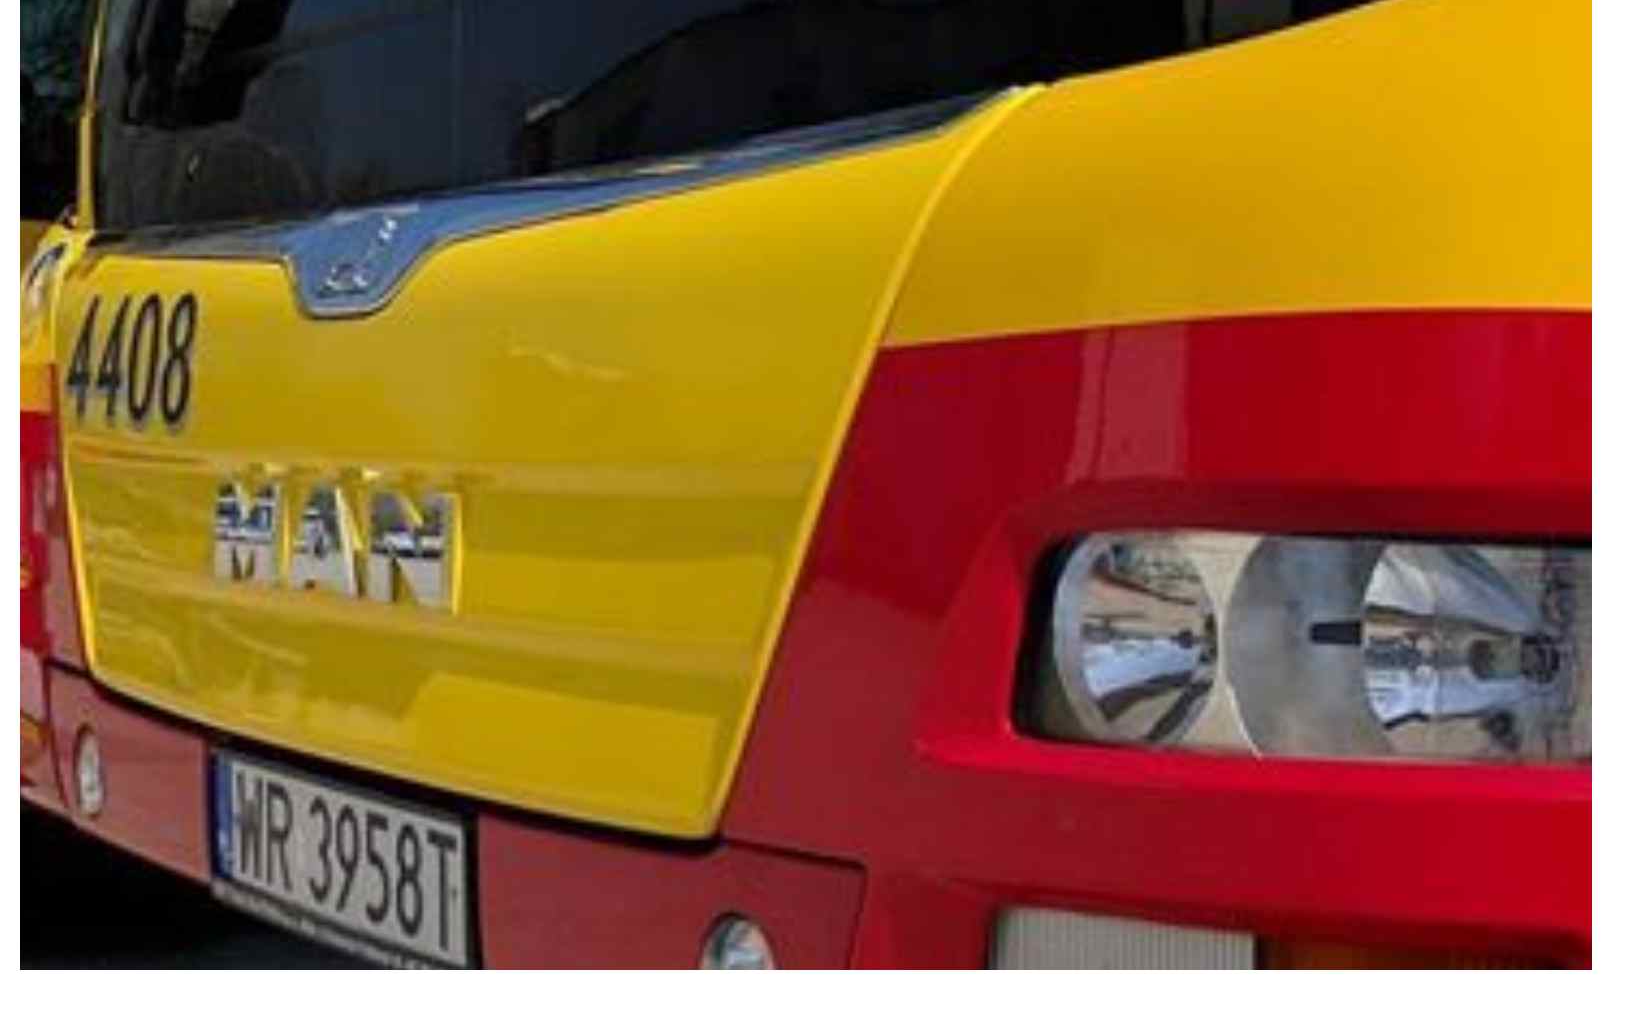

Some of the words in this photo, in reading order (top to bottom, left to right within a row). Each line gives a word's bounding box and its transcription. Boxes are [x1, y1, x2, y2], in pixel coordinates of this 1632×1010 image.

[66, 292, 199, 428] 4408
[215, 483, 463, 614] MAN
[236, 769, 294, 892] WR
[308, 794, 458, 952] 3958T
